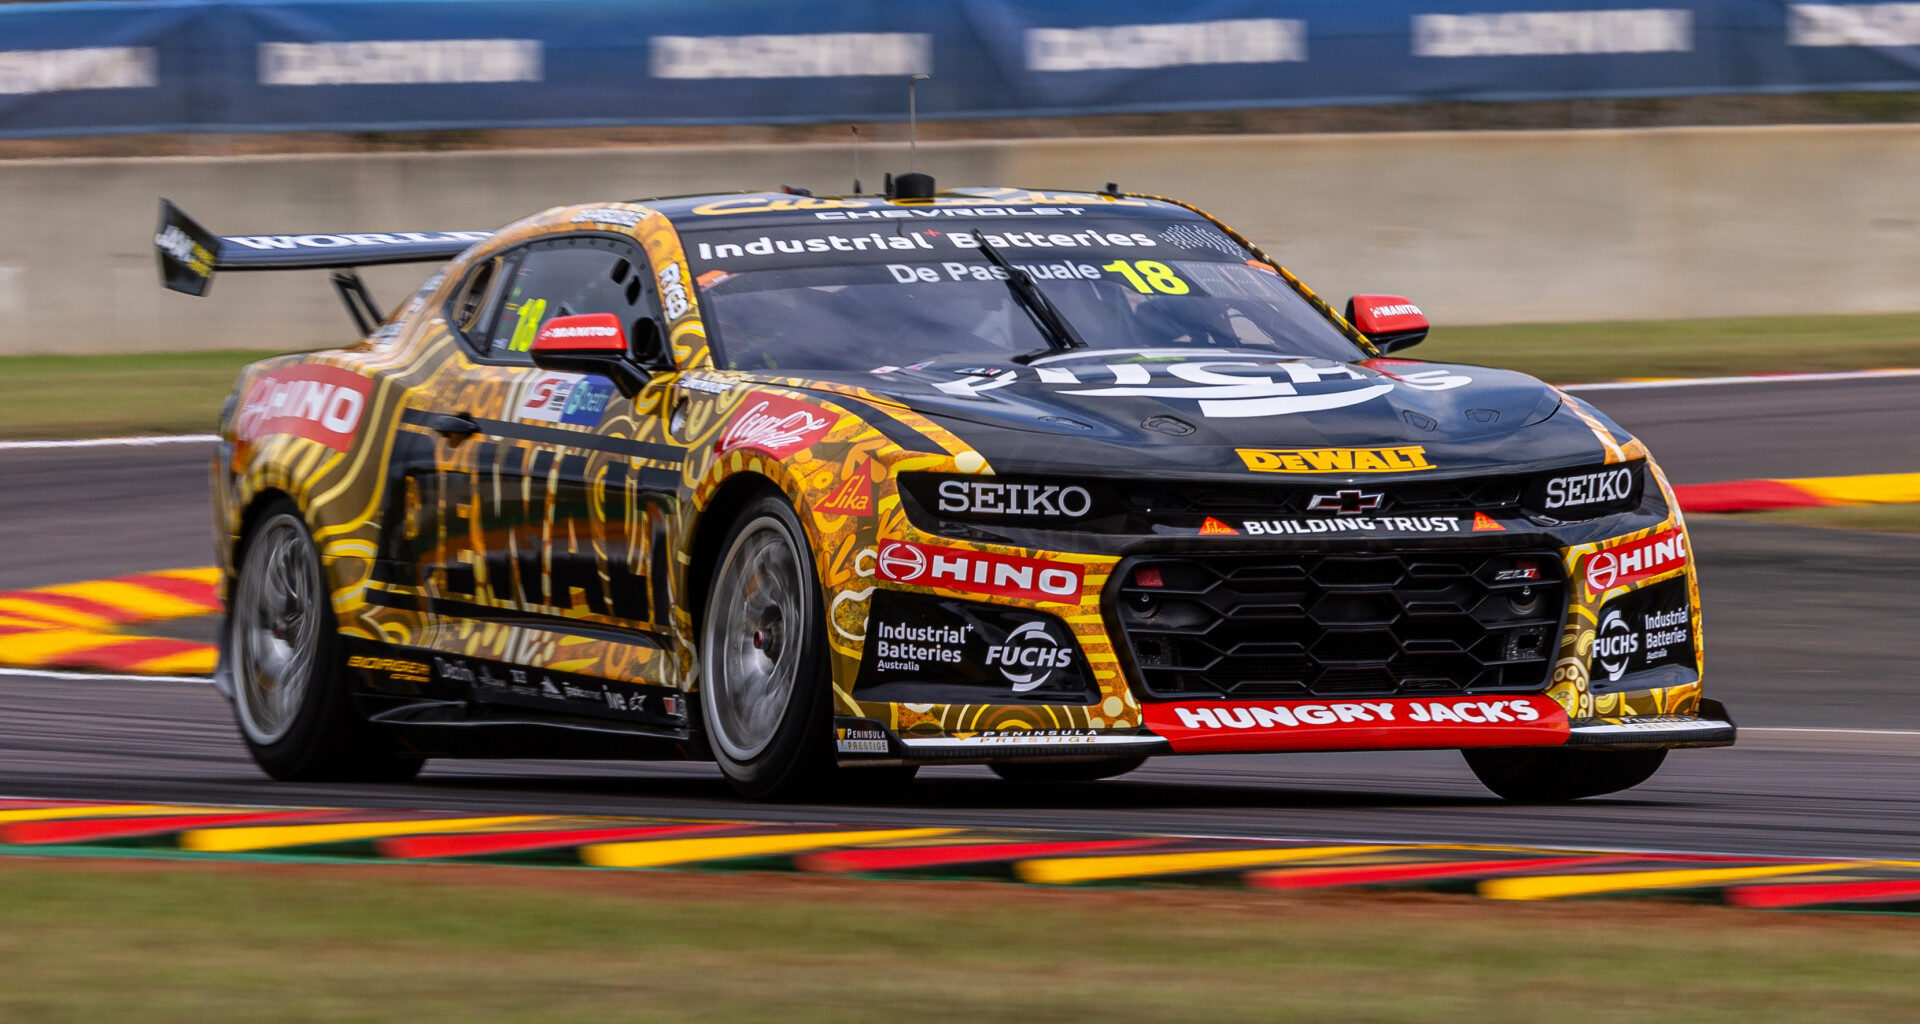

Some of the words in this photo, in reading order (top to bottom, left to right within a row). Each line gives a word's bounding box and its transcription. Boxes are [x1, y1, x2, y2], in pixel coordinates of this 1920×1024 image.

[814, 207, 1086, 221] CHEVROLET
[946, 229, 1156, 248] Batteries
[886, 264, 941, 284] De
[1102, 260, 1190, 295] 18
[1244, 448, 1430, 471] DEWALT
[938, 480, 1091, 517] SEIKO
[1545, 468, 1632, 509] SEIKO
[1243, 518, 1376, 535] BUILDING
[1377, 516, 1460, 532] TRUST
[931, 554, 1078, 596] HINO
[1495, 568, 1536, 580] ZL1
[1592, 632, 1639, 658] FUCHS
[1645, 626, 1687, 649] Batteries
[877, 640, 962, 663] Batteries
[985, 646, 1072, 668] FUCHS
[877, 659, 920, 672] Australia
[1174, 702, 1396, 729] HUNGRY
[1408, 700, 1540, 723] JACK'S
[847, 728, 886, 739] PENINSULA
[983, 729, 1098, 737] PENINSULA
[847, 741, 887, 751] PRESTIGE
